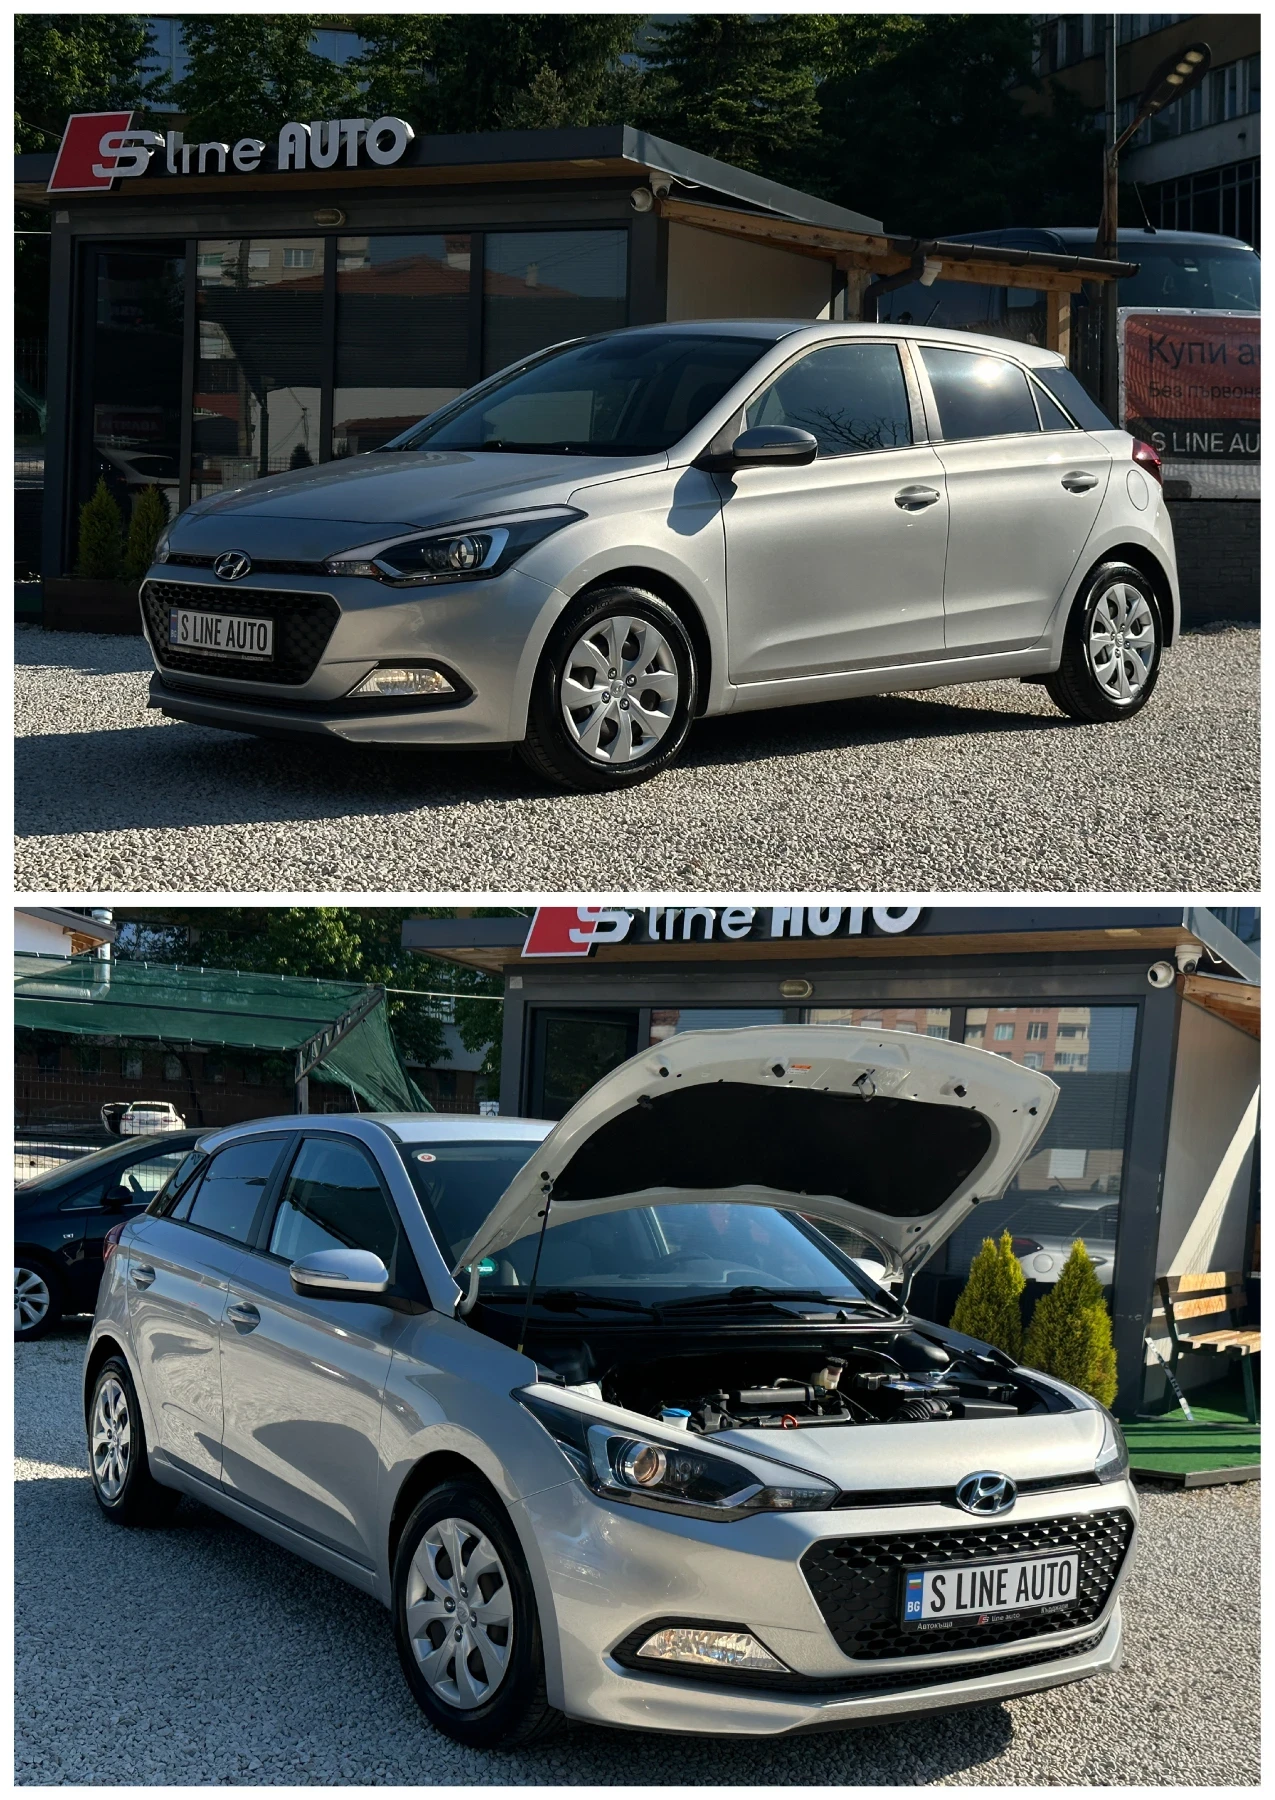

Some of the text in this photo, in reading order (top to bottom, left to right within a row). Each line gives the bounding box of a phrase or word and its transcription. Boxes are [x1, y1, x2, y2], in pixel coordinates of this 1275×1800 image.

[91, 116, 408, 177] S line AUTO
[1148, 334, 1261, 369] Купи а
[1149, 381, 1182, 398] Без
[1151, 431, 1166, 452] S
[1173, 432, 1224, 453] LINE
[181, 614, 268, 651] S LINE AUTO
[930, 1560, 1072, 1612] S LINE AUTO
[907, 1601, 921, 1612] BG
[917, 1621, 953, 1631] Автокъща
